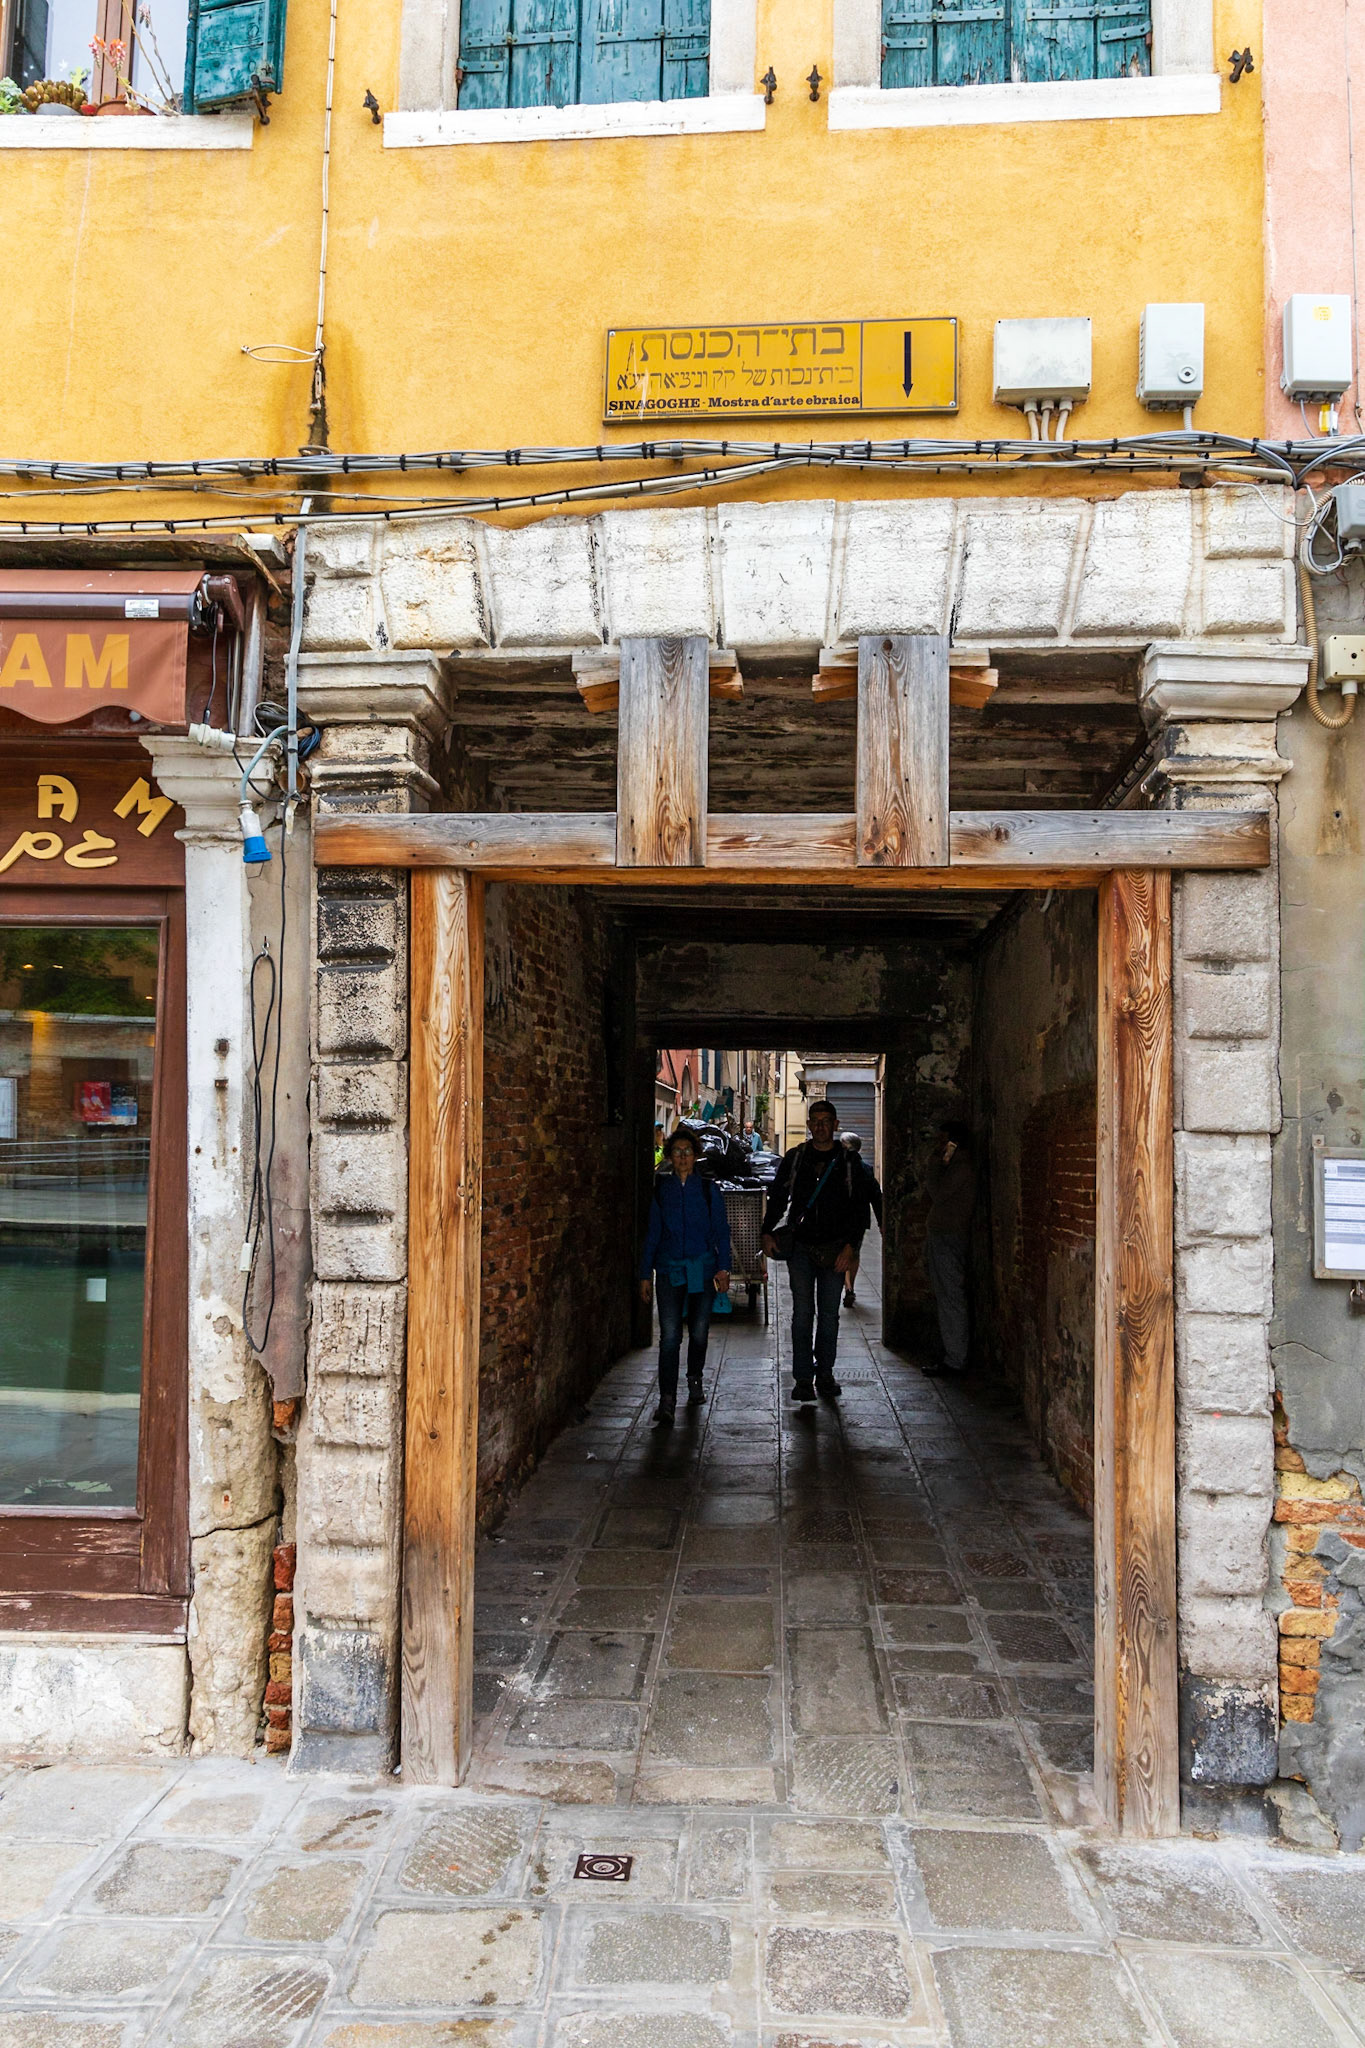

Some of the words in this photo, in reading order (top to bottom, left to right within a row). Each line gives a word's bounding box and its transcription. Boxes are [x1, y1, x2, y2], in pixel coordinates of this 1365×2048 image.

[741, 360, 767, 386] של
[608, 397, 701, 411] SINAGOGHE
[707, 396, 760, 408] Mostra
[805, 394, 860, 405] ebraica
